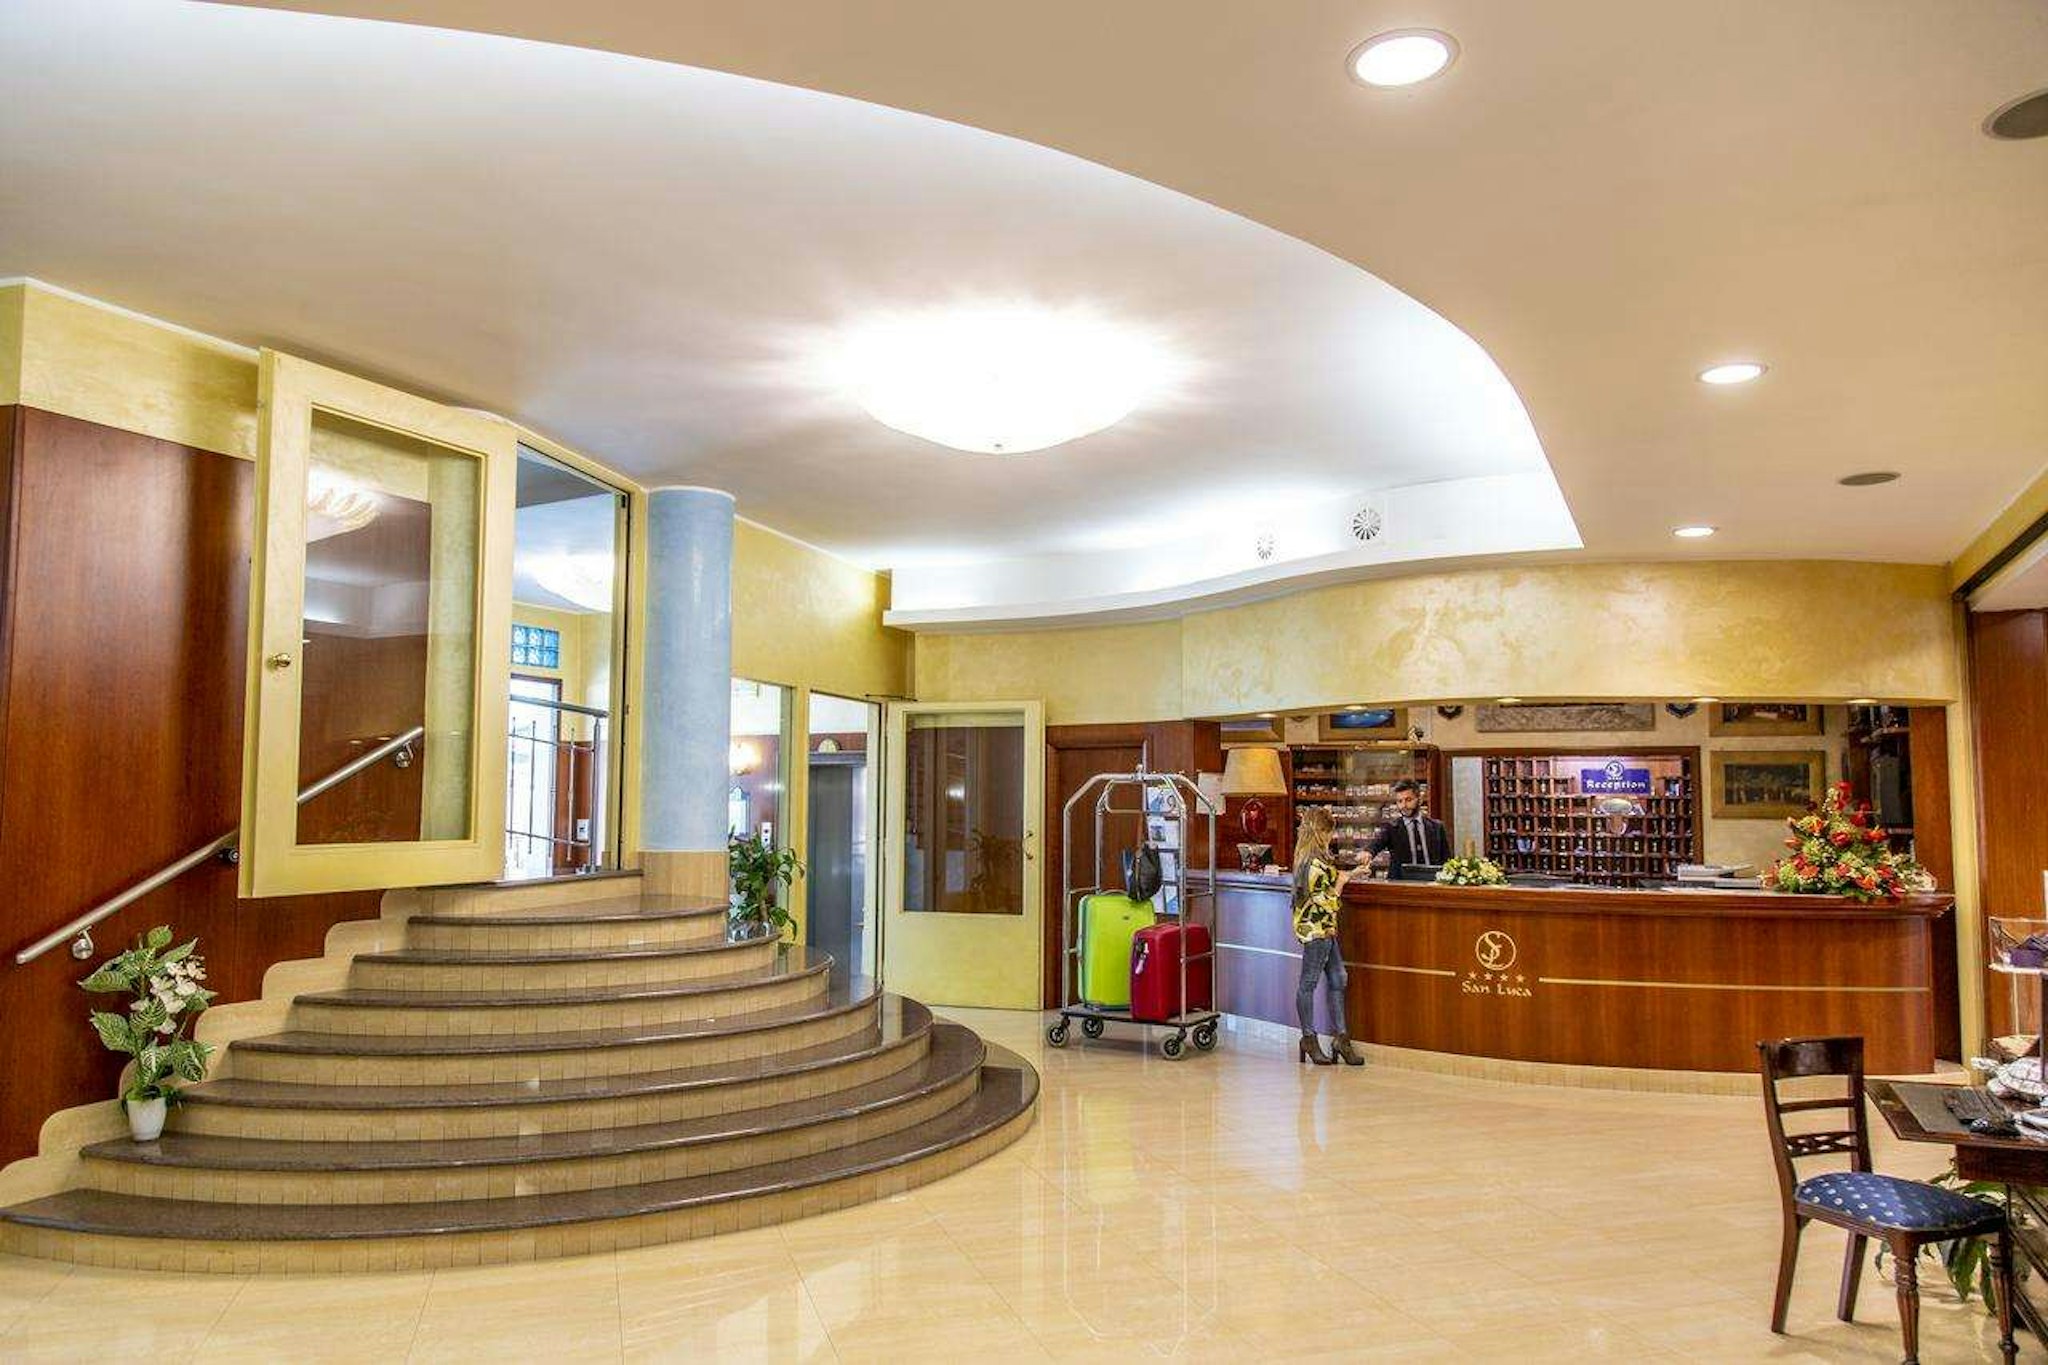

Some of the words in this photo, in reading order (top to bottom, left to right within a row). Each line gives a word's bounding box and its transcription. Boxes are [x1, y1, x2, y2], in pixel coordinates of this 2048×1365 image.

[1586, 780, 1646, 791] Reception
[1461, 980, 1491, 994] San
[1496, 983, 1533, 997] Luca
